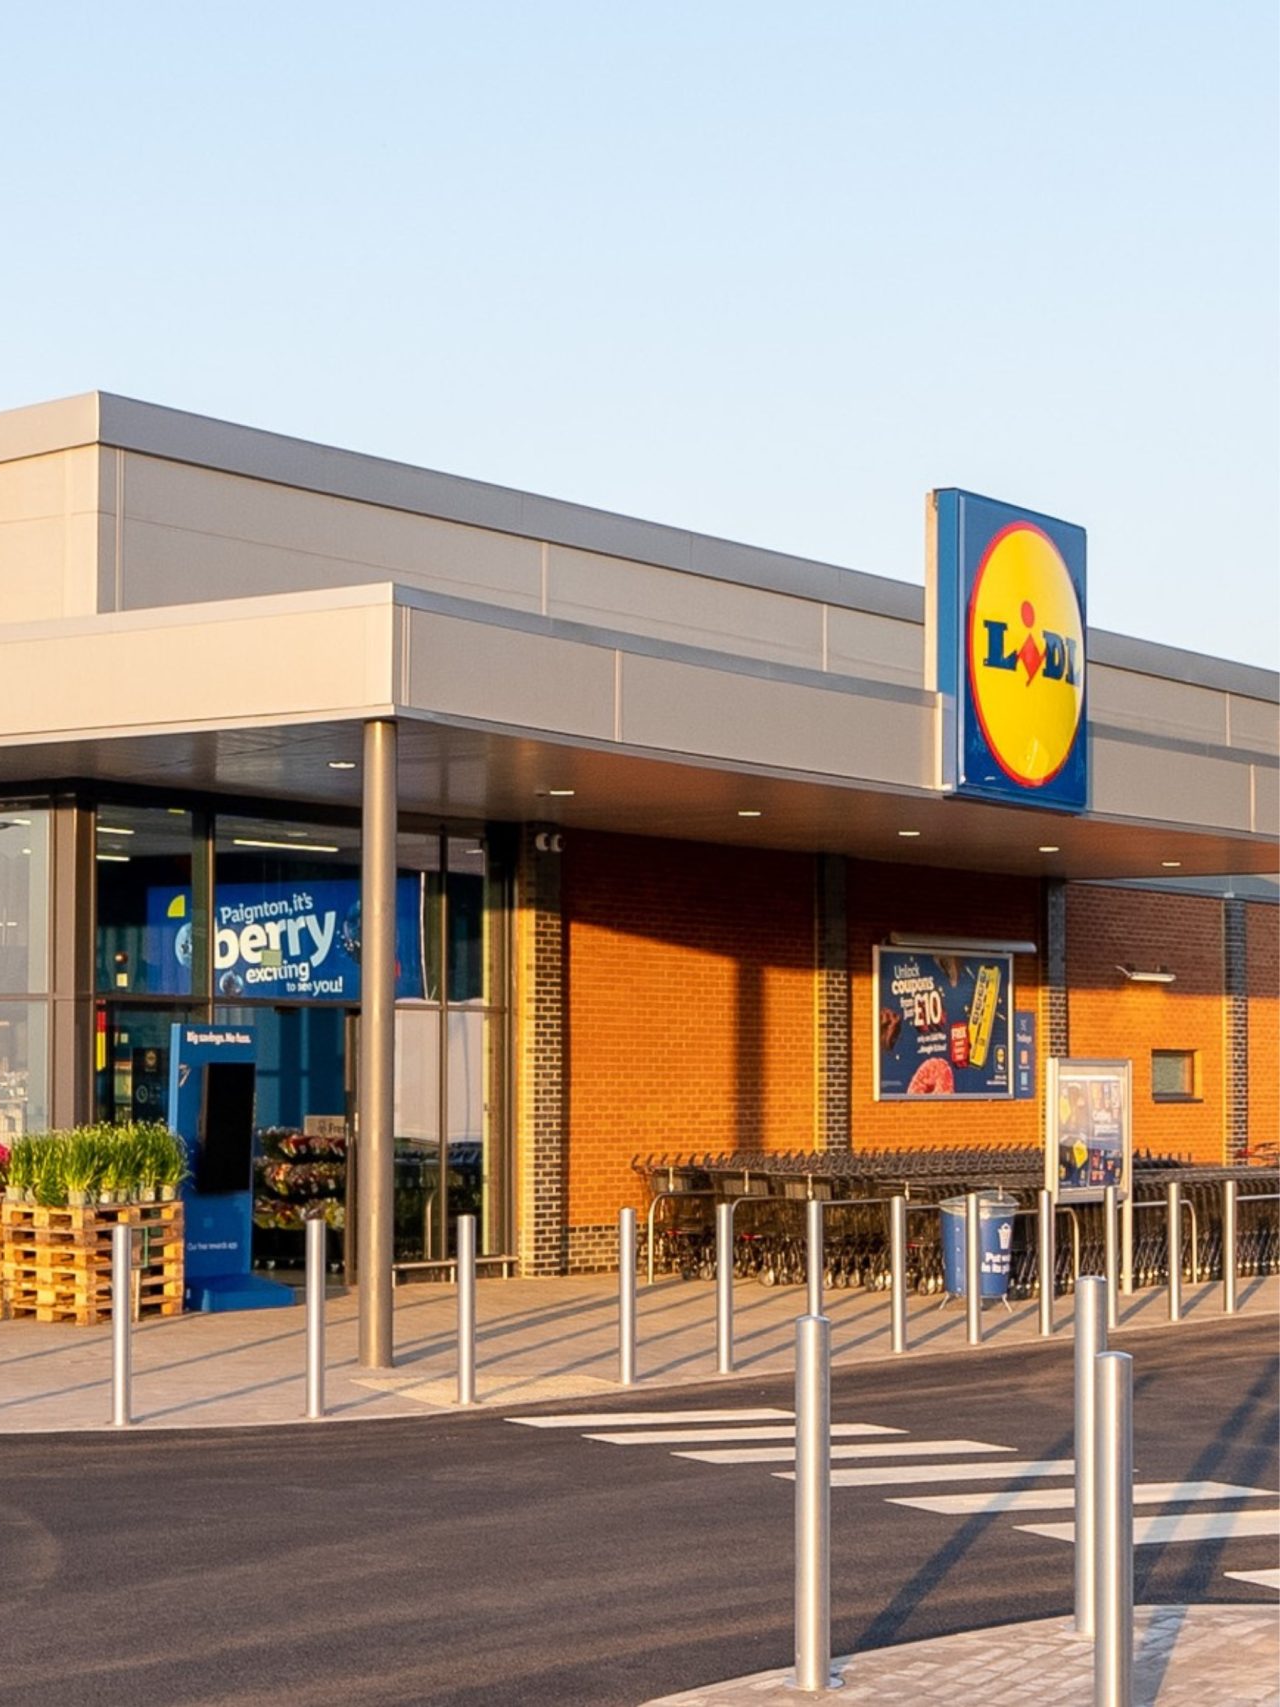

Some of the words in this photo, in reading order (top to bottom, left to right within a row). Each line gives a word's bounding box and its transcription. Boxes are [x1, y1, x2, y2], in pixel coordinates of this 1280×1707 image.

[220, 900, 293, 924] Paignton,
[293, 892, 314, 911] it's
[214, 910, 336, 969] berry
[286, 982, 295, 992] to
[313, 976, 343, 997] you!
[914, 990, 942, 1026] £10
